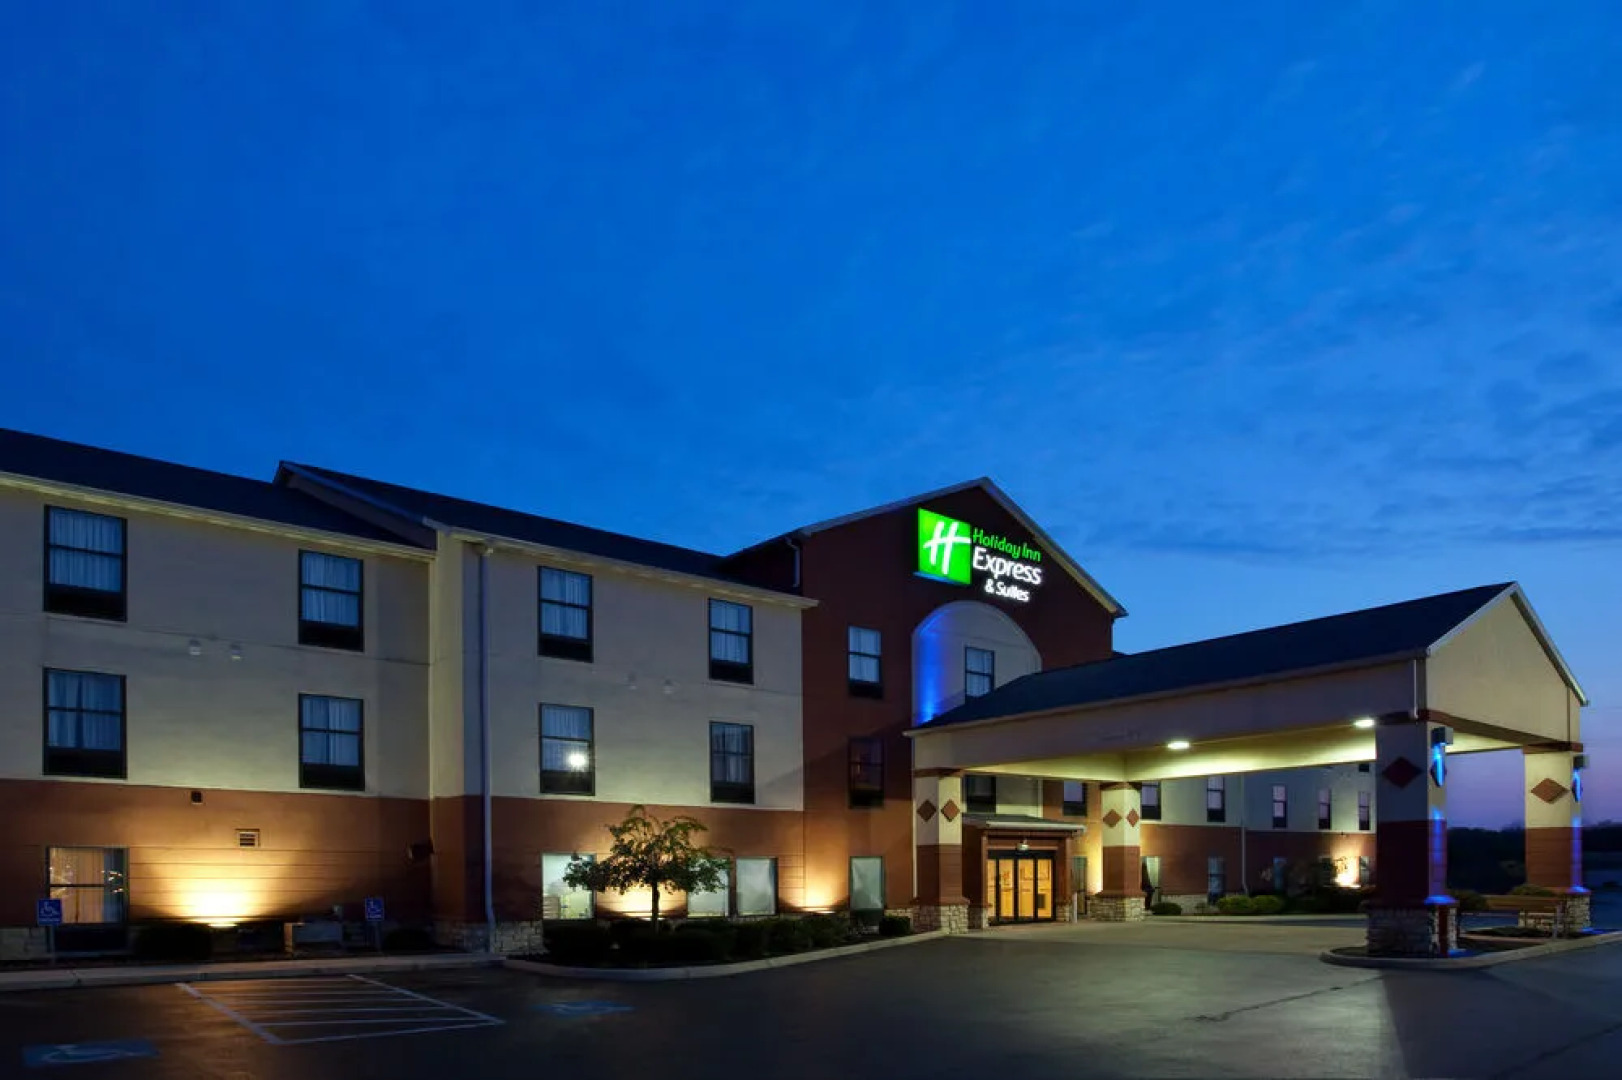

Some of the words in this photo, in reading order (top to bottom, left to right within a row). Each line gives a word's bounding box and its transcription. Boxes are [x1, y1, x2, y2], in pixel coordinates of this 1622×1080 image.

[973, 527, 1021, 558] Holiday
[1022, 542, 1041, 562] Inn
[972, 545, 1042, 585] Express
[984, 578, 994, 594] &
[995, 581, 1030, 602] Suites
